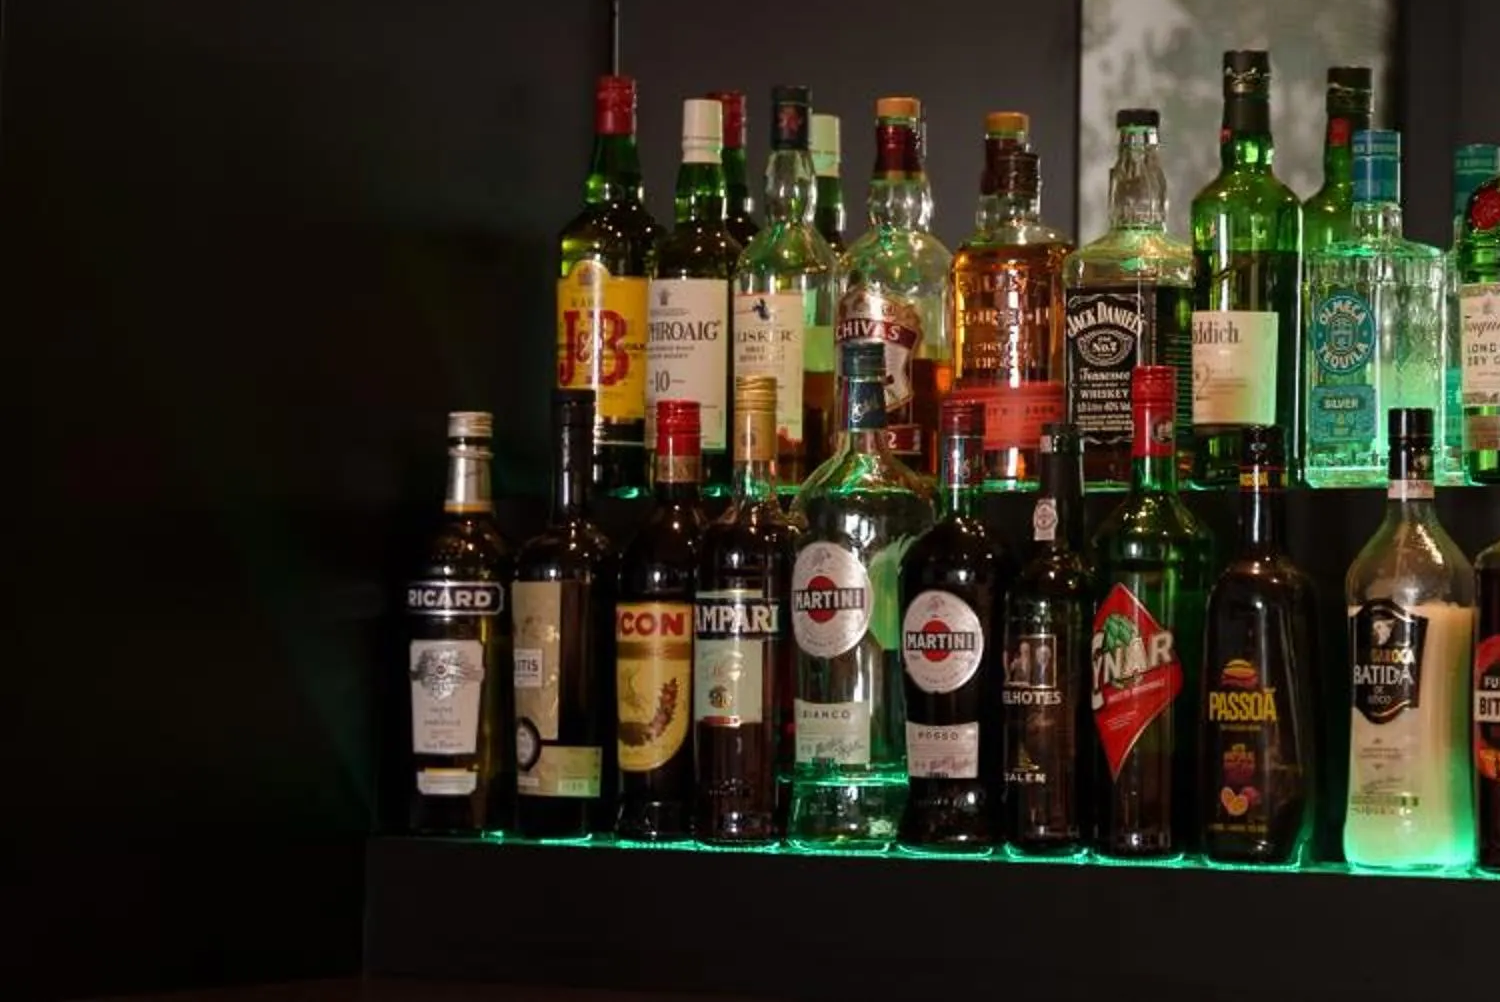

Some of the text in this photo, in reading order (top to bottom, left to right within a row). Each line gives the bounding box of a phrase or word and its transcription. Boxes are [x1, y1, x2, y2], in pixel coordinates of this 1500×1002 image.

[1067, 306, 1097, 338] JACK
[1319, 299, 1367, 325] OLMECA
[835, 320, 900, 341] CHIVAS
[1319, 341, 1369, 369] TEQUILA
[1079, 389, 1130, 399] WHISKEY
[1323, 397, 1359, 410] SILVER
[407, 589, 492, 608] RICARD
[794, 588, 865, 611] MARTINI
[905, 632, 976, 651] MARTINI
[1352, 664, 1416, 686] BATIDA
[801, 708, 851, 720] BIANCO
[917, 730, 960, 742] ROSSO
